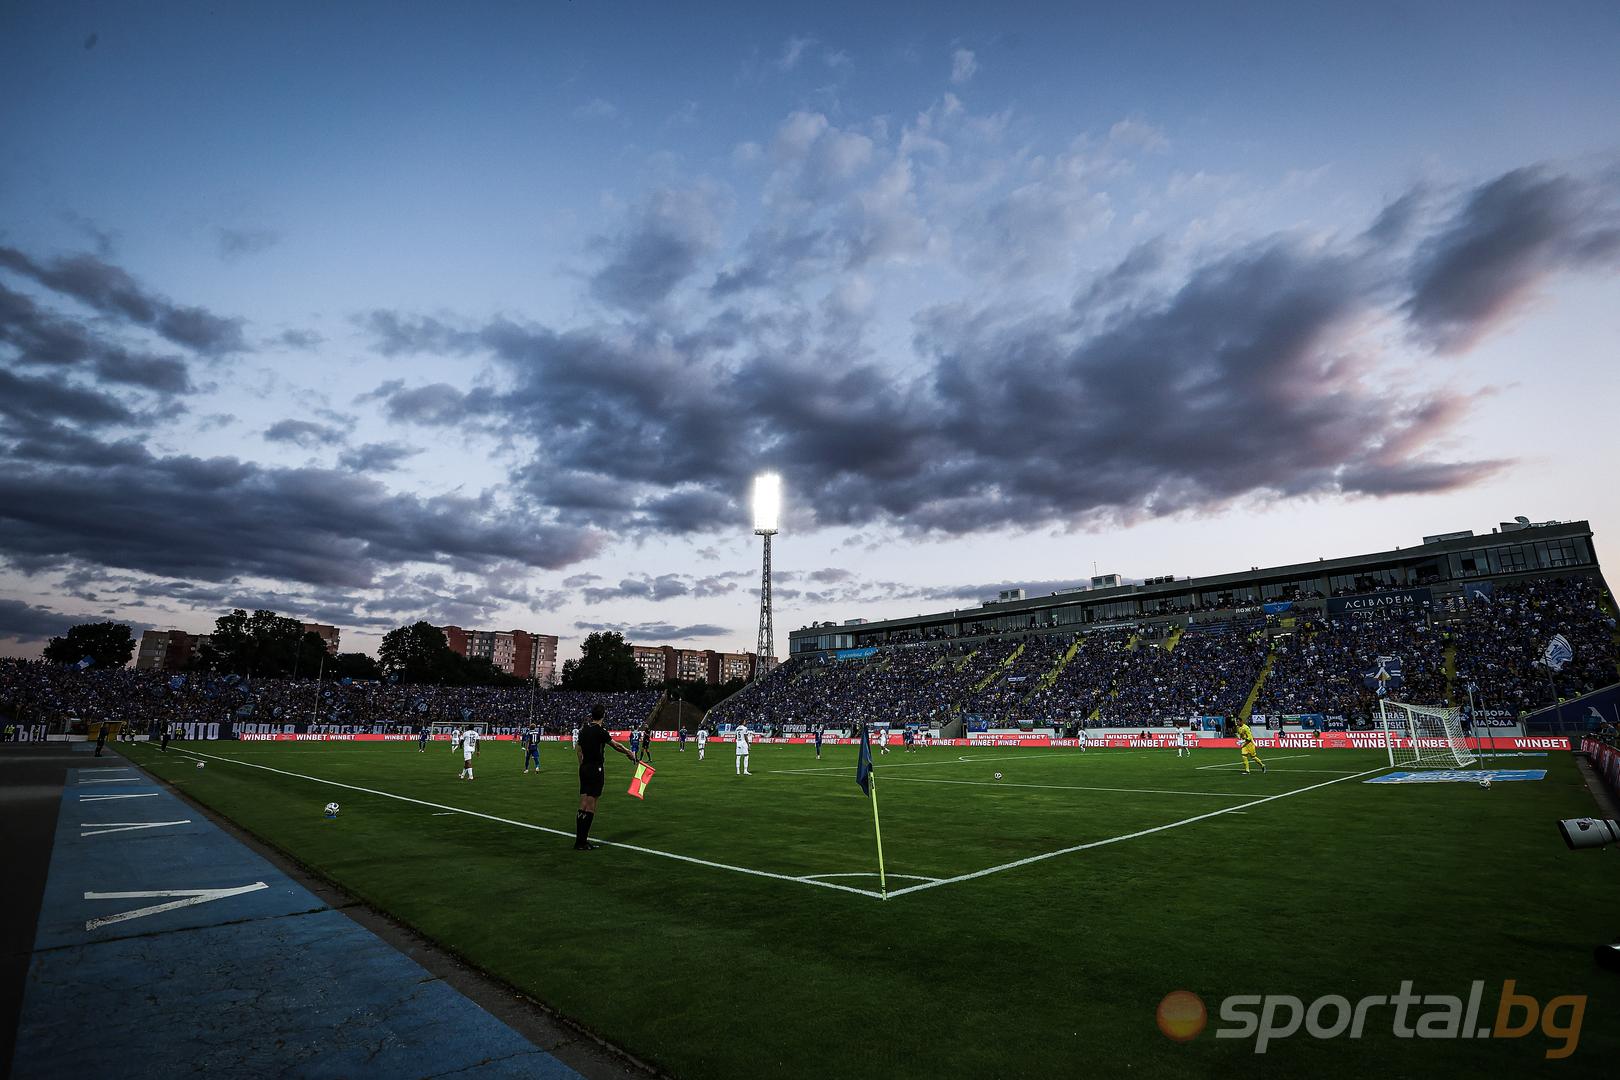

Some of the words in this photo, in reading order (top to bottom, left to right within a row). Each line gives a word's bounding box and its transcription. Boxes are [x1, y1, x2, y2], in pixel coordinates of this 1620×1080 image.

[1345, 595, 1414, 609] ACIBADEM
[1129, 739, 1166, 748] WINBET
[1279, 739, 1324, 748] WINBET
[1352, 739, 1402, 748] WINBET
[1514, 739, 1568, 748] WINBET
